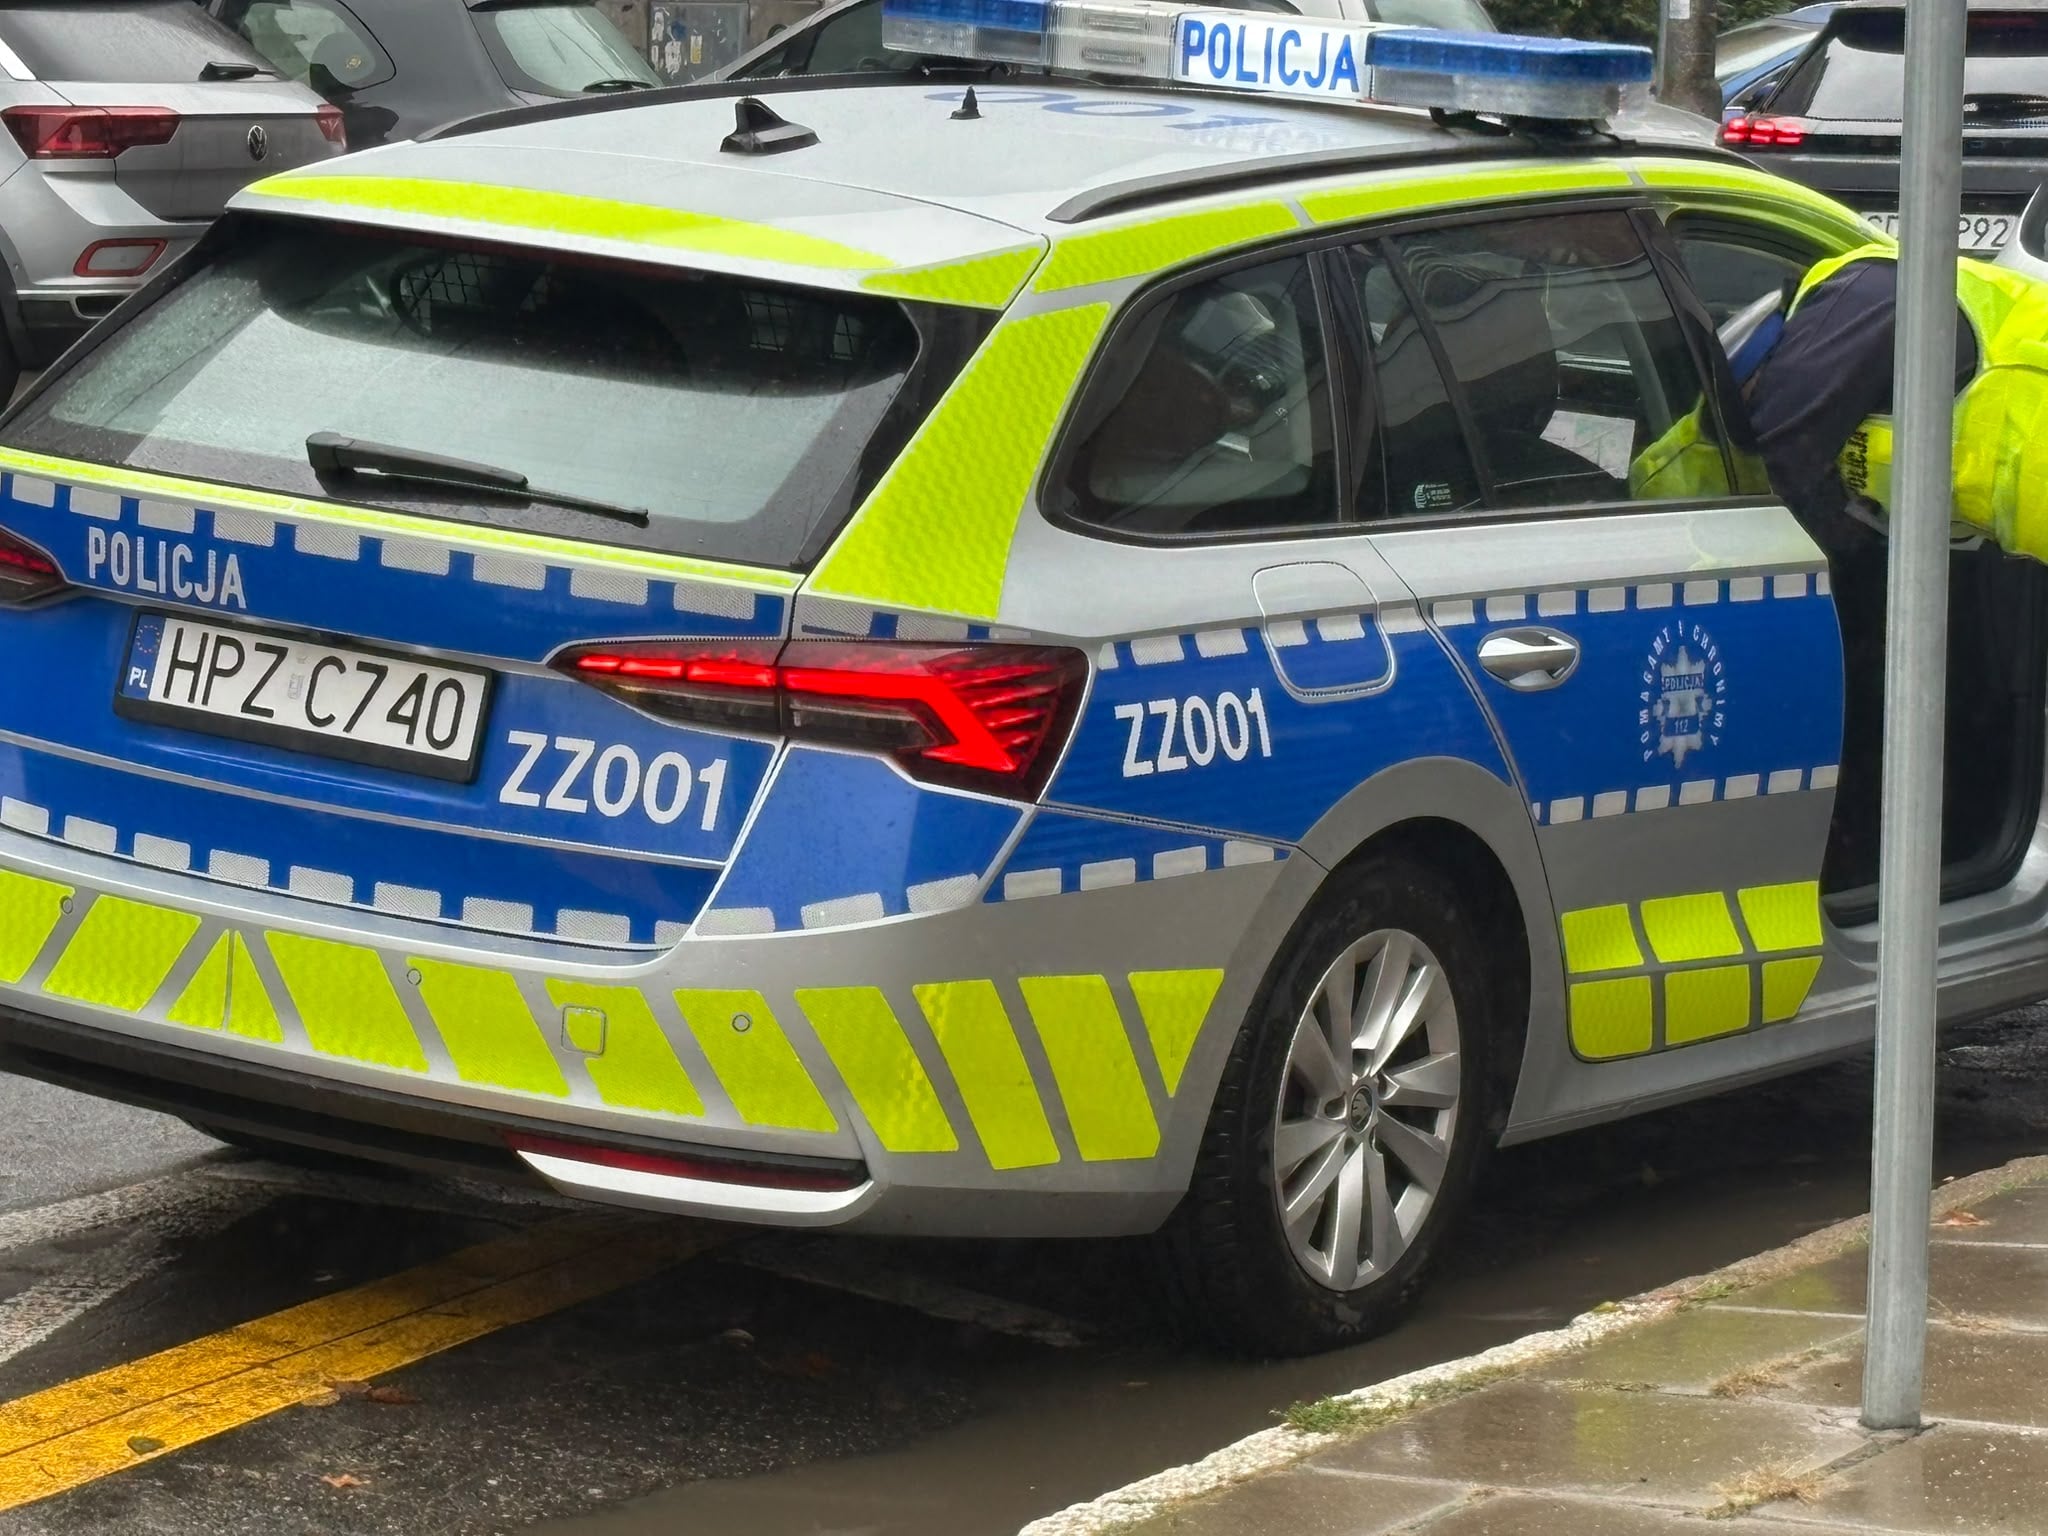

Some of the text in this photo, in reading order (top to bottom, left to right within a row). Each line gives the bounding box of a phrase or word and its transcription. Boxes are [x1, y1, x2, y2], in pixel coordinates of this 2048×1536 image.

[1182, 19, 1360, 93] POLICJA
[88, 527, 247, 609] POLICJA
[129, 666, 148, 689] PL
[163, 627, 465, 751] HPZ C740
[1640, 627, 1670, 762] POMAGAMY
[1693, 624, 1726, 747] CHRONIMY
[1665, 675, 1701, 691] POLICJA
[1114, 687, 1272, 778] ZZ001
[1674, 718, 1689, 733] 112
[499, 730, 728, 831] ZZ001
